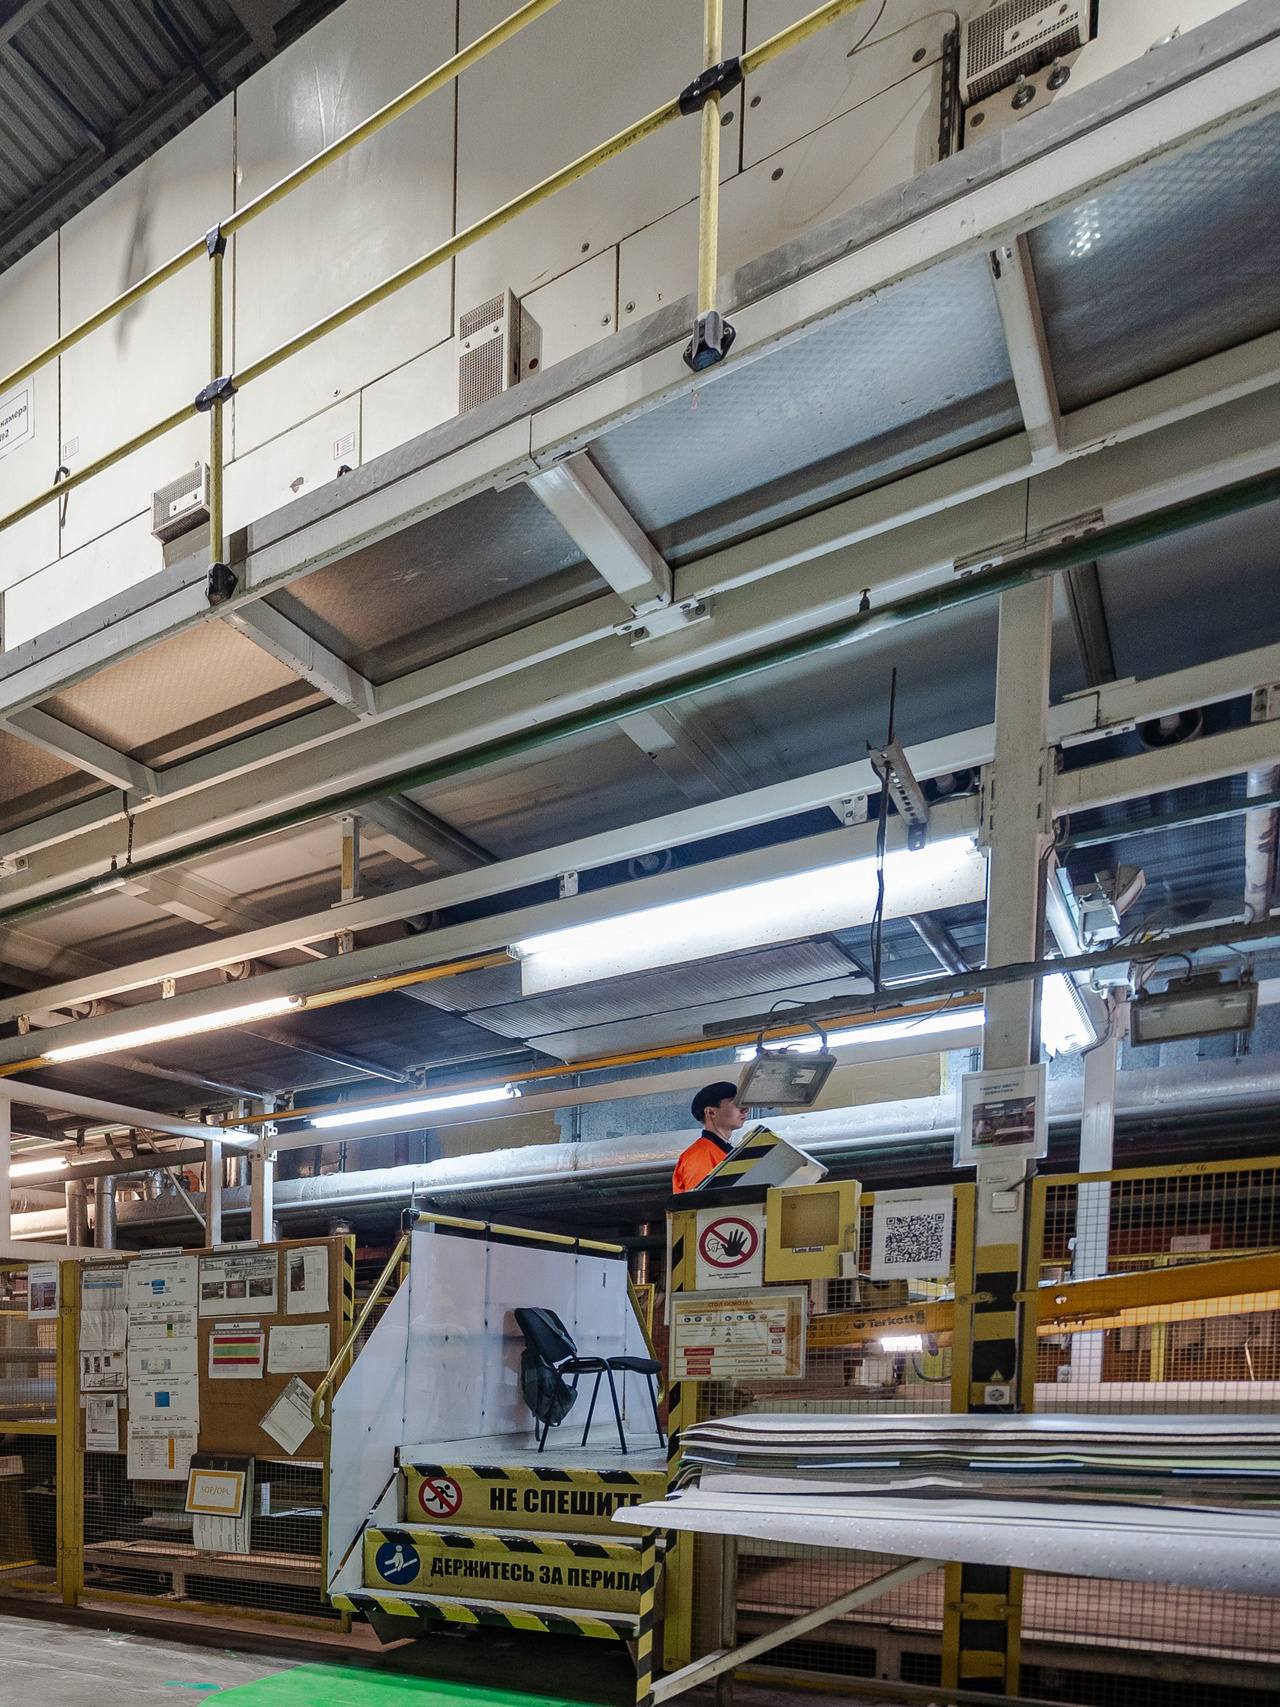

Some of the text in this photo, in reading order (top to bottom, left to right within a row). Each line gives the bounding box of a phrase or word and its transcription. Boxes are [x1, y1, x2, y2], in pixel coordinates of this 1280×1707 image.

[867, 1314, 915, 1328] Tarkett
[201, 1486, 230, 1495] SOP/OPL
[490, 1487, 517, 1511] НЕ
[430, 1557, 641, 1592] ДЕРЖИТЕСЬ ЗА ПЕРИЛА
